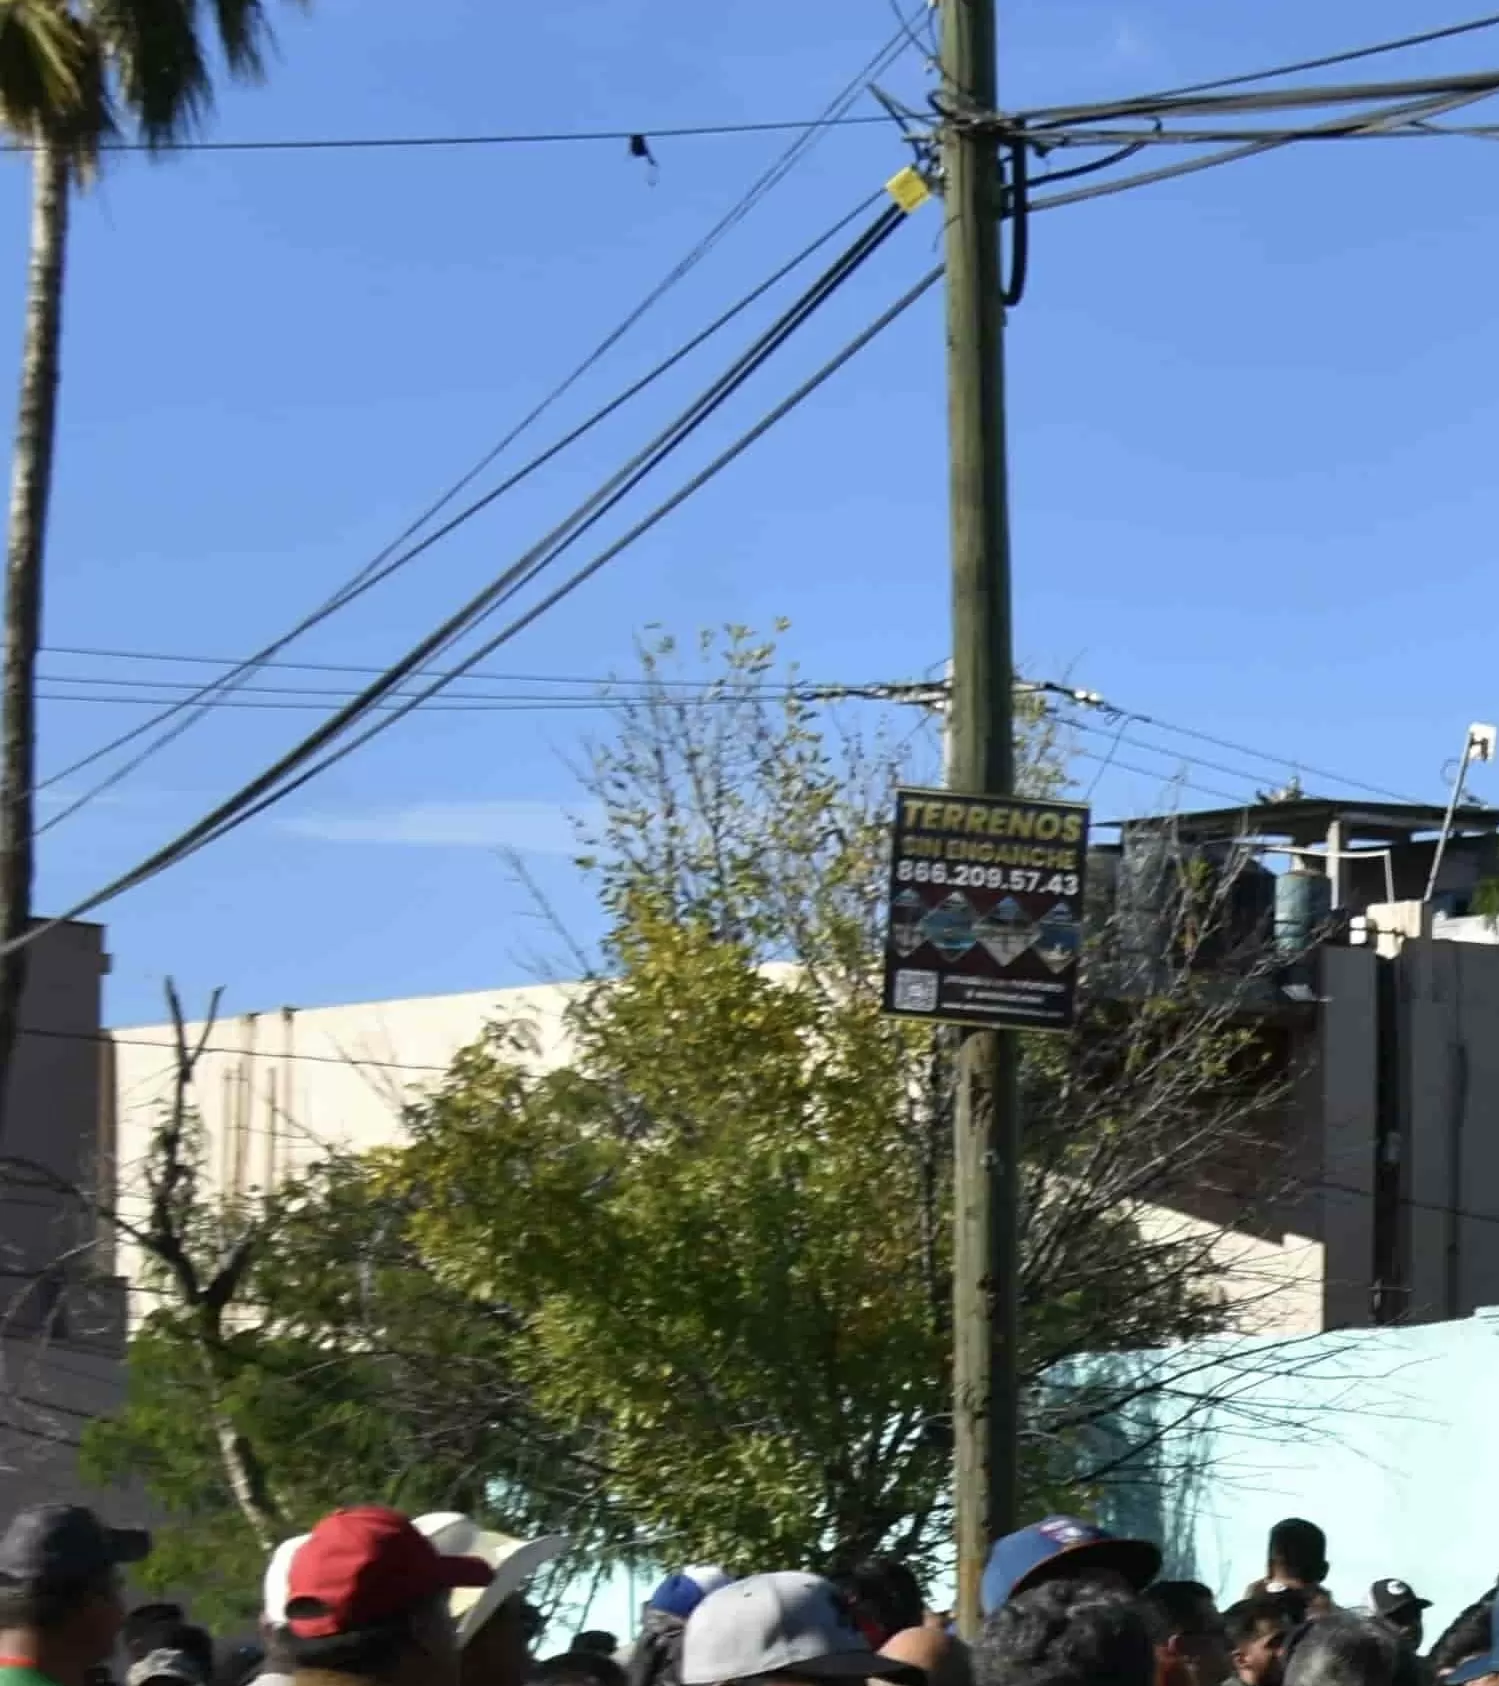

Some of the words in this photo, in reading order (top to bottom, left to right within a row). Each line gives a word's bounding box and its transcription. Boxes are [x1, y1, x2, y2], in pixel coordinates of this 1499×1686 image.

[902, 799, 1083, 843] TERRENOS
[902, 835, 942, 859] SIN
[945, 838, 1078, 871] ENGANCHE
[897, 859, 1080, 896] 866.209.57.43
